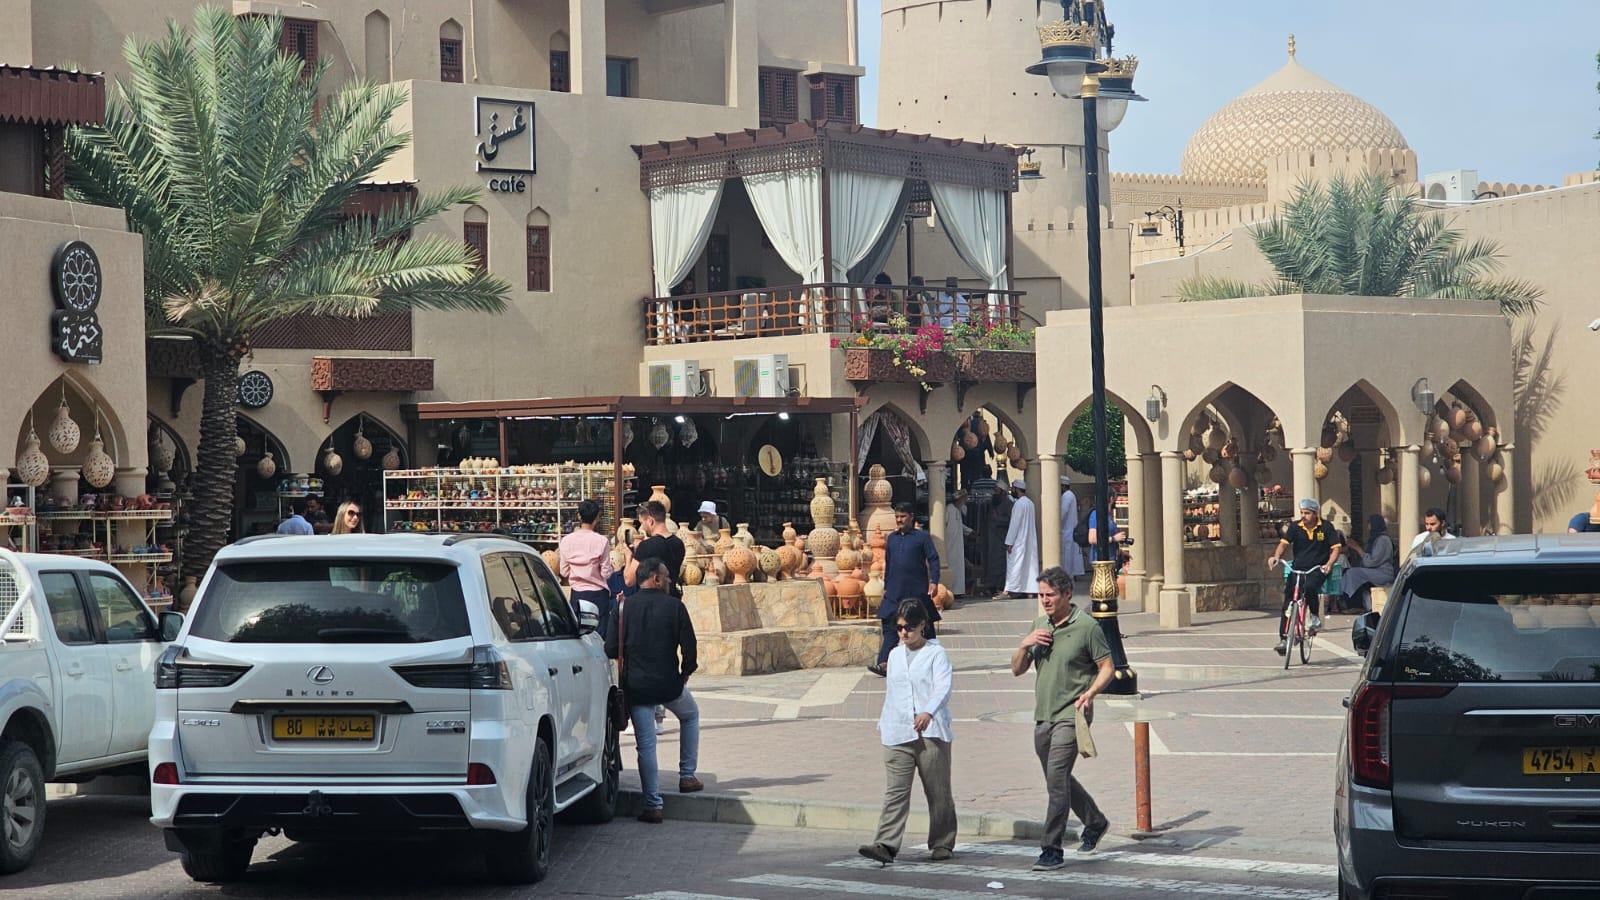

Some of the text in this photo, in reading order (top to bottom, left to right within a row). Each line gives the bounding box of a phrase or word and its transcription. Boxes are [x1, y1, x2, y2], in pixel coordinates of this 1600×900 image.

[487, 174, 526, 193] café
[287, 719, 303, 736] 80
[1531, 747, 1574, 771] 4754
